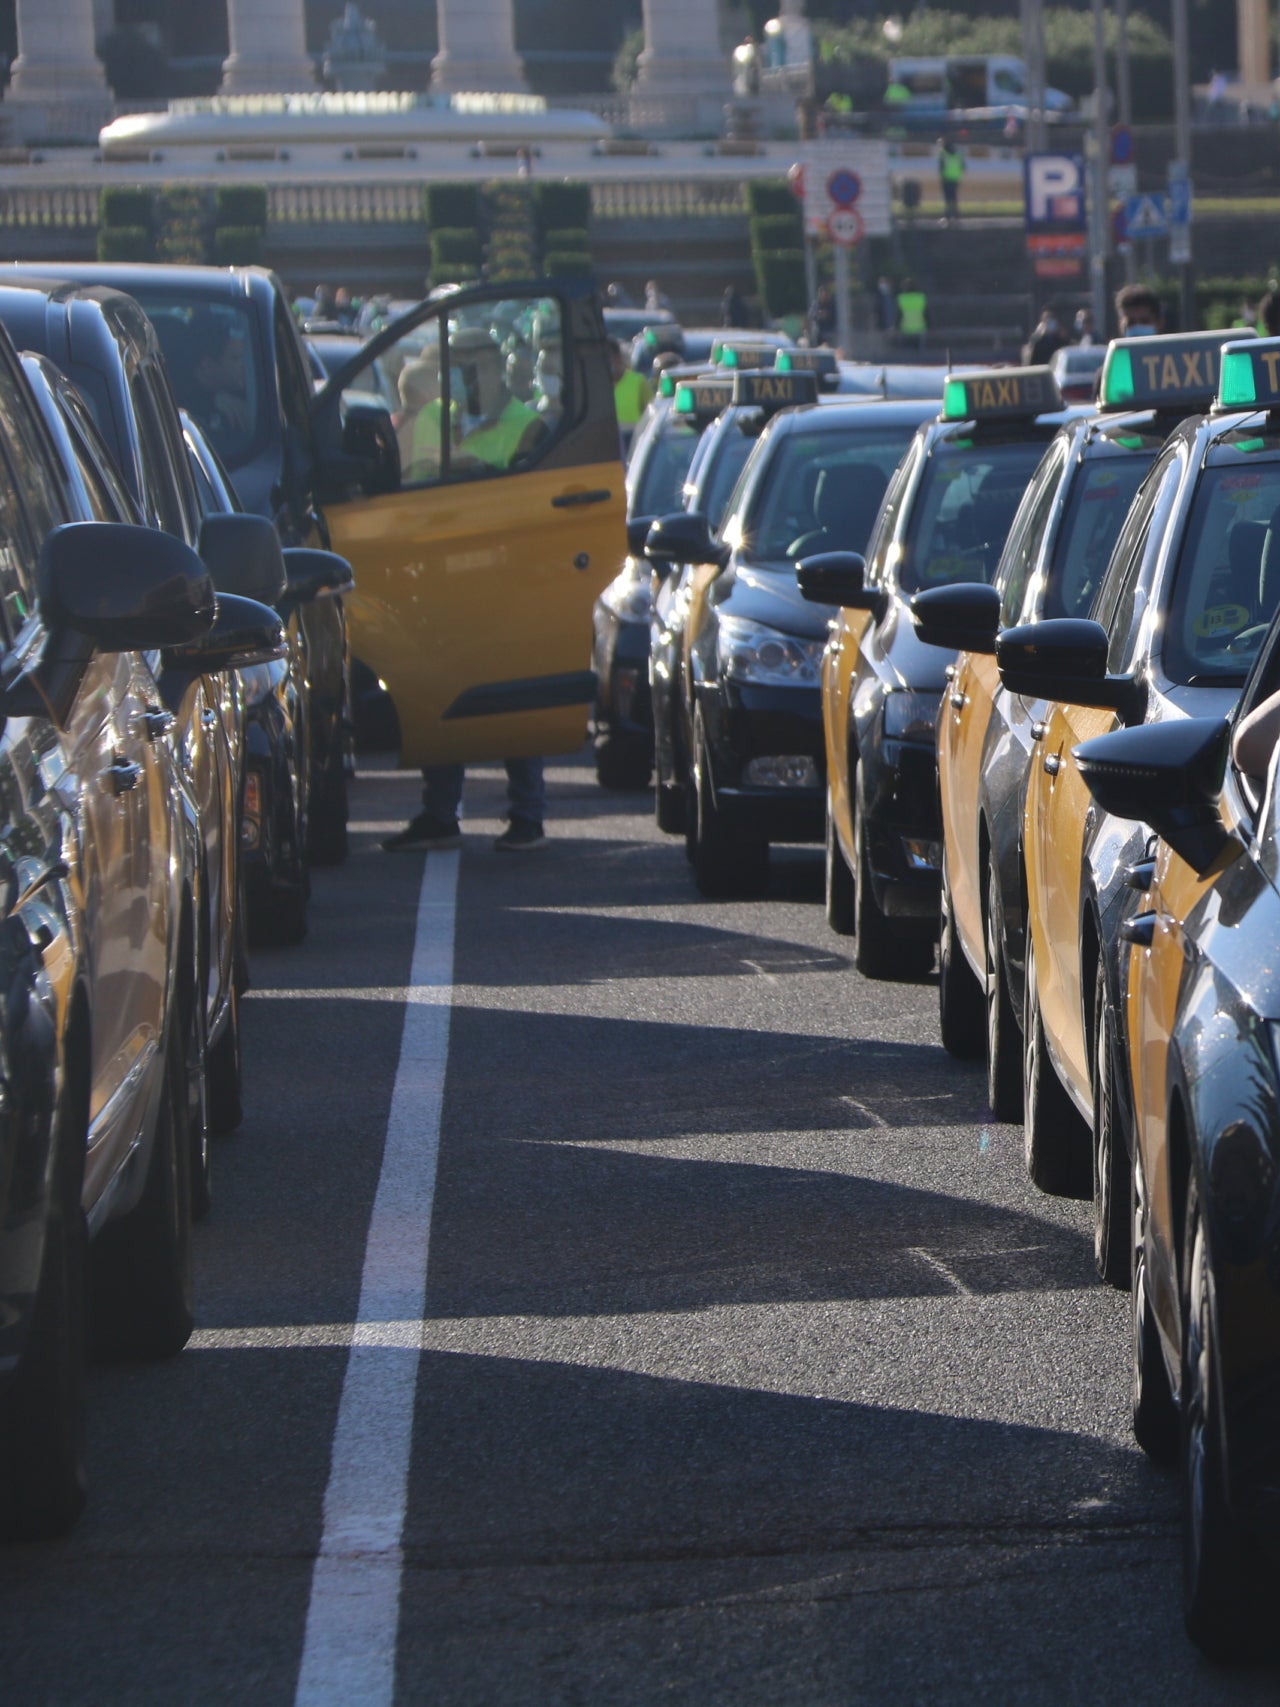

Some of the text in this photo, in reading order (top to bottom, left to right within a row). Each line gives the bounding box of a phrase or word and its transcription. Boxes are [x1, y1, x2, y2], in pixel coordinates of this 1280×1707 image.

[1029, 155, 1079, 219] P
[753, 377, 793, 399] TAXI
[1142, 351, 1215, 391] TAXI
[970, 378, 1019, 409] TAXI
